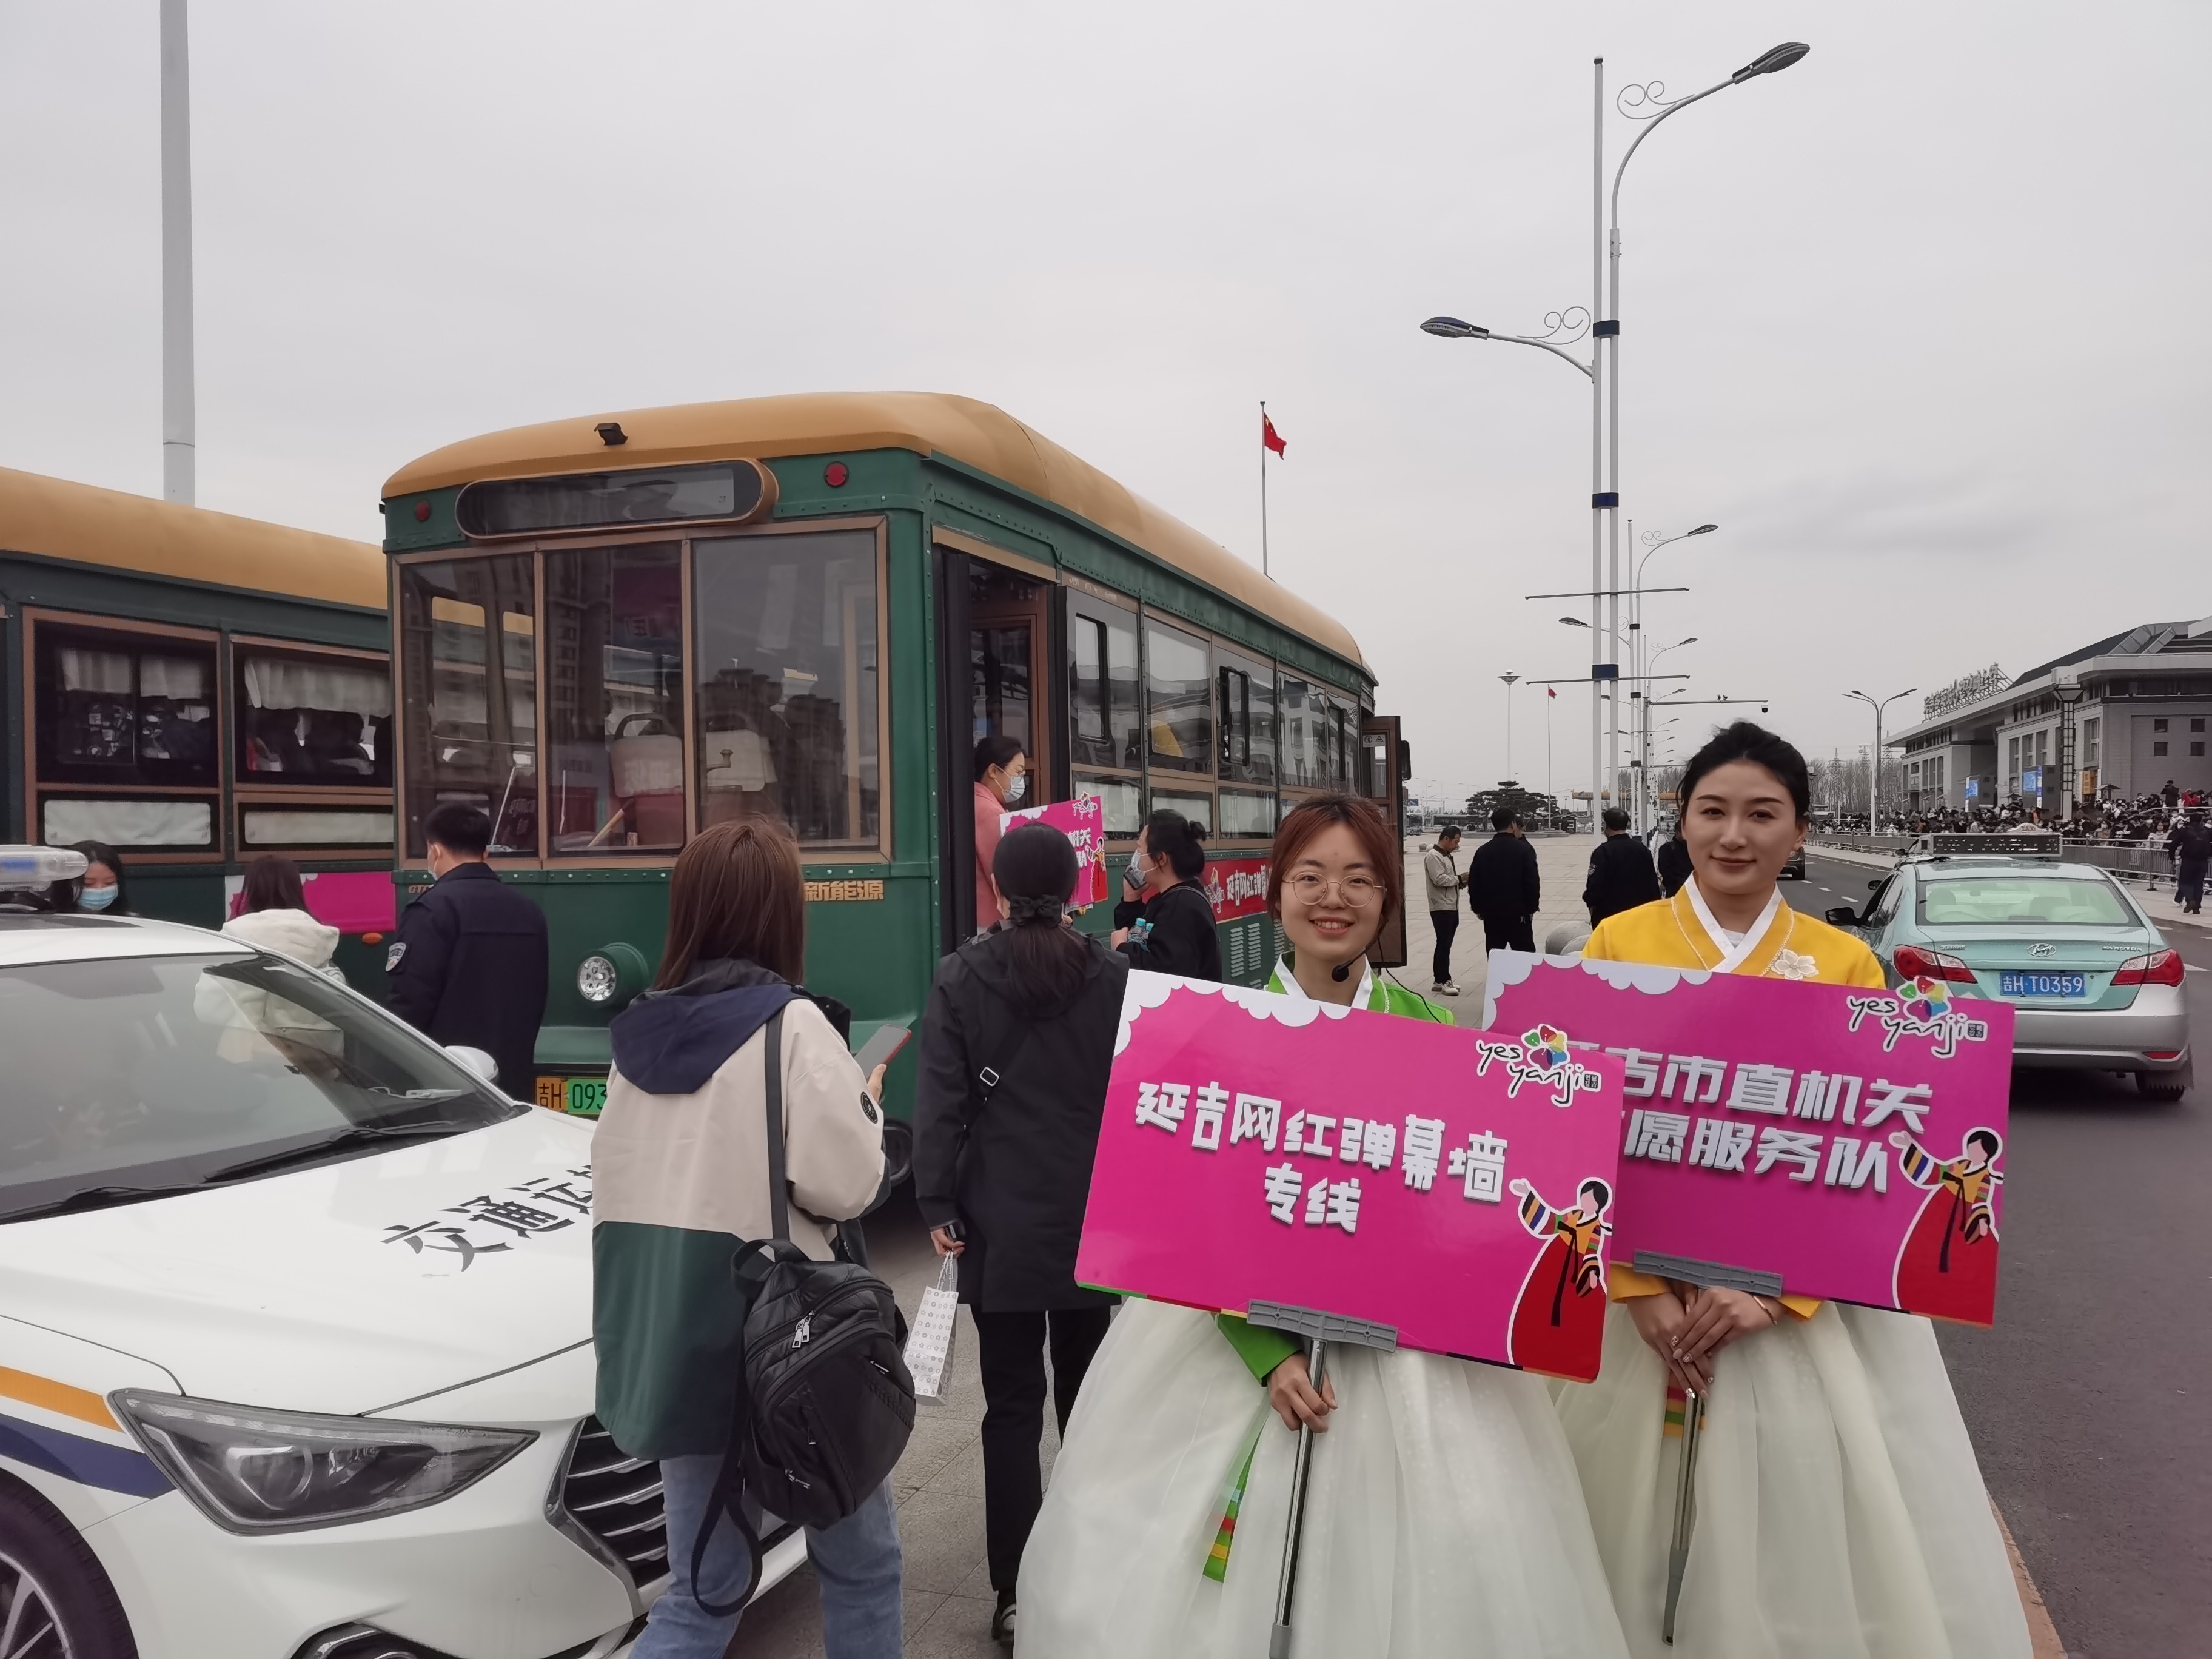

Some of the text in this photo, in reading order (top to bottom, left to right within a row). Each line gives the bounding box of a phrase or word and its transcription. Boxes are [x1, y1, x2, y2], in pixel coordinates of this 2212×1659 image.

[804, 880, 883, 902] 新能源
[1227, 865, 1272, 906] 延吉网红弹幕
[1849, 998, 1895, 1030] yes
[1884, 1015, 1965, 1056] yanji
[1479, 1042, 1521, 1073] yes
[1509, 1064, 1581, 1104] yanji
[1567, 1041, 1932, 1133] 吉市直机关
[1135, 1081, 1508, 1203] 延吉网红弹幕墙
[1621, 1108, 1888, 1193] 愿服务队
[1264, 1162, 1361, 1233] 专线
